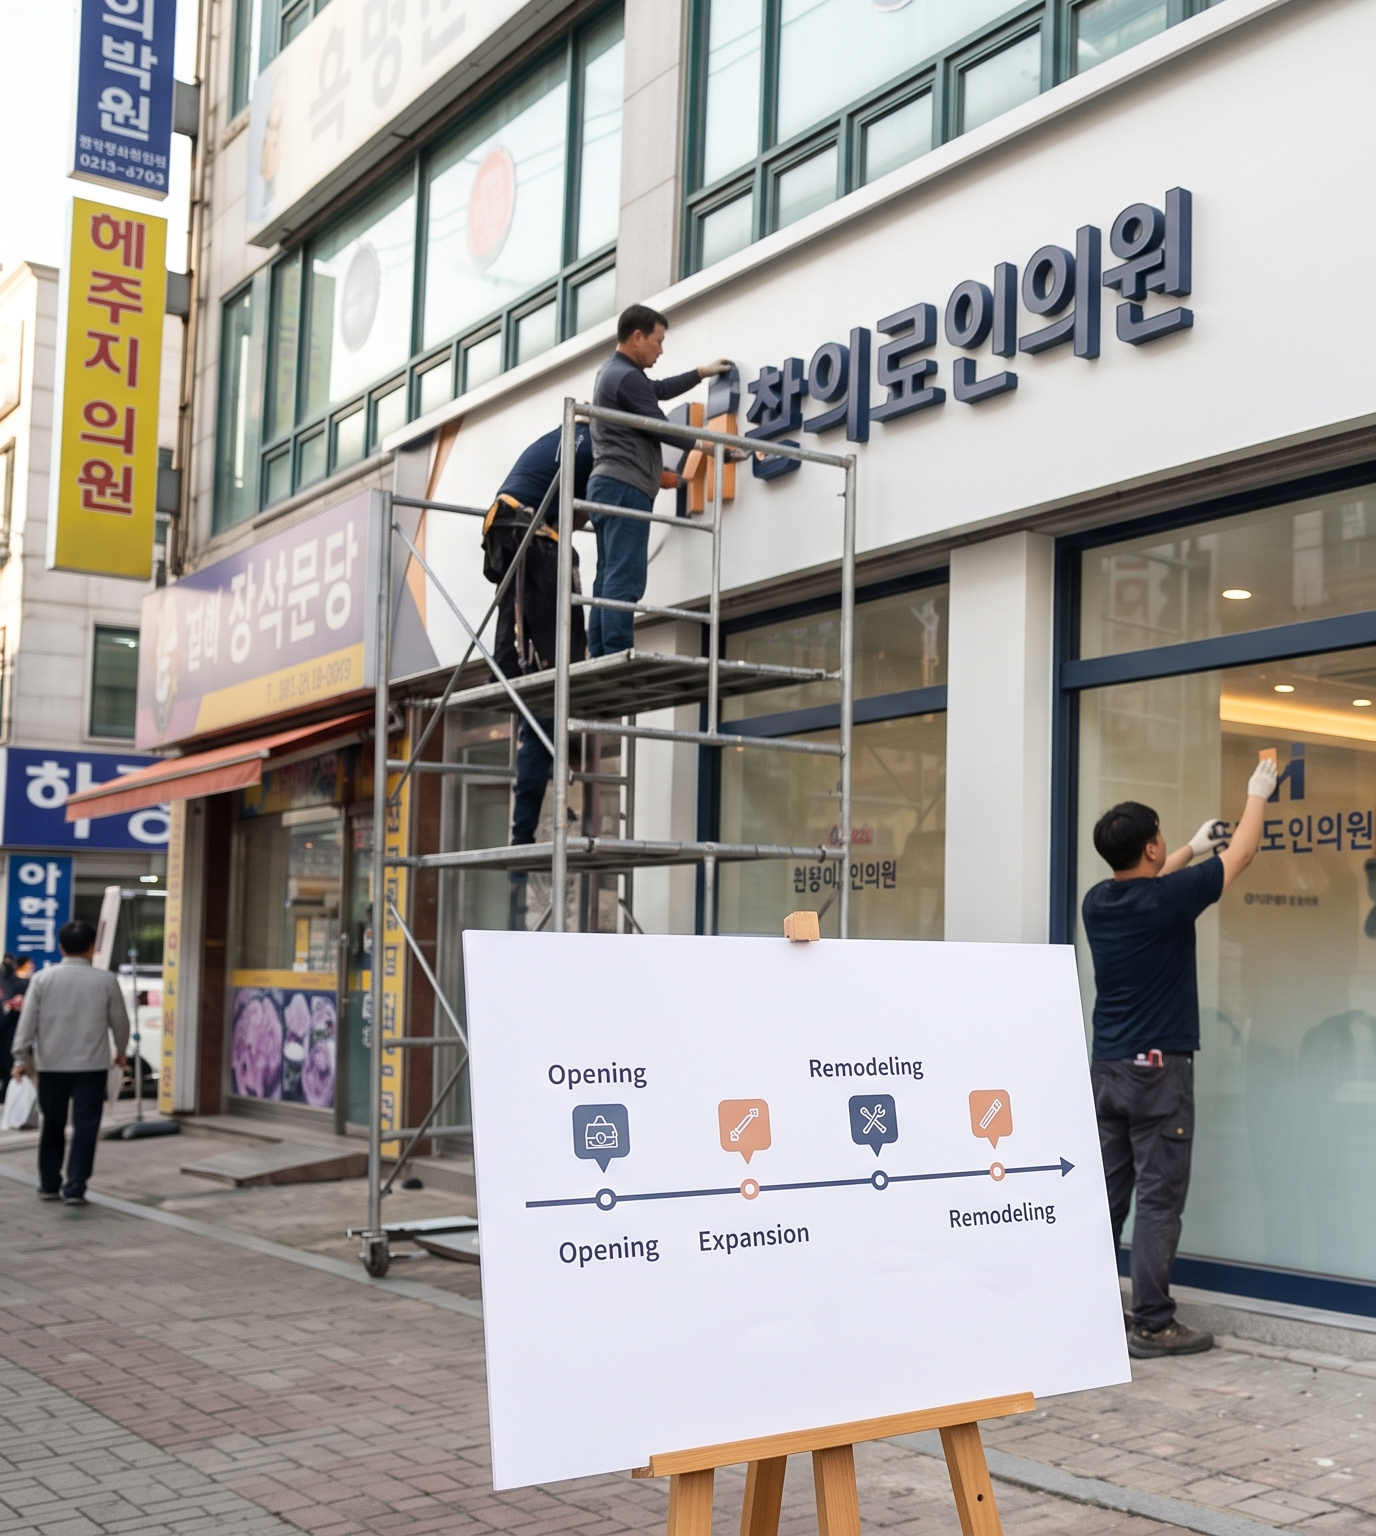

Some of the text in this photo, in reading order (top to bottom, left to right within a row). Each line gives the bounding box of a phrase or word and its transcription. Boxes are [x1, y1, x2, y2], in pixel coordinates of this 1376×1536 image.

[77, 212, 146, 517] 헤주지의원
[547, 1062, 648, 1090] Opening
[809, 1056, 924, 1080] Remodeling
[949, 1202, 1056, 1228] Remodeling
[559, 1236, 660, 1268] Opening
[699, 1223, 810, 1254] Expansion
